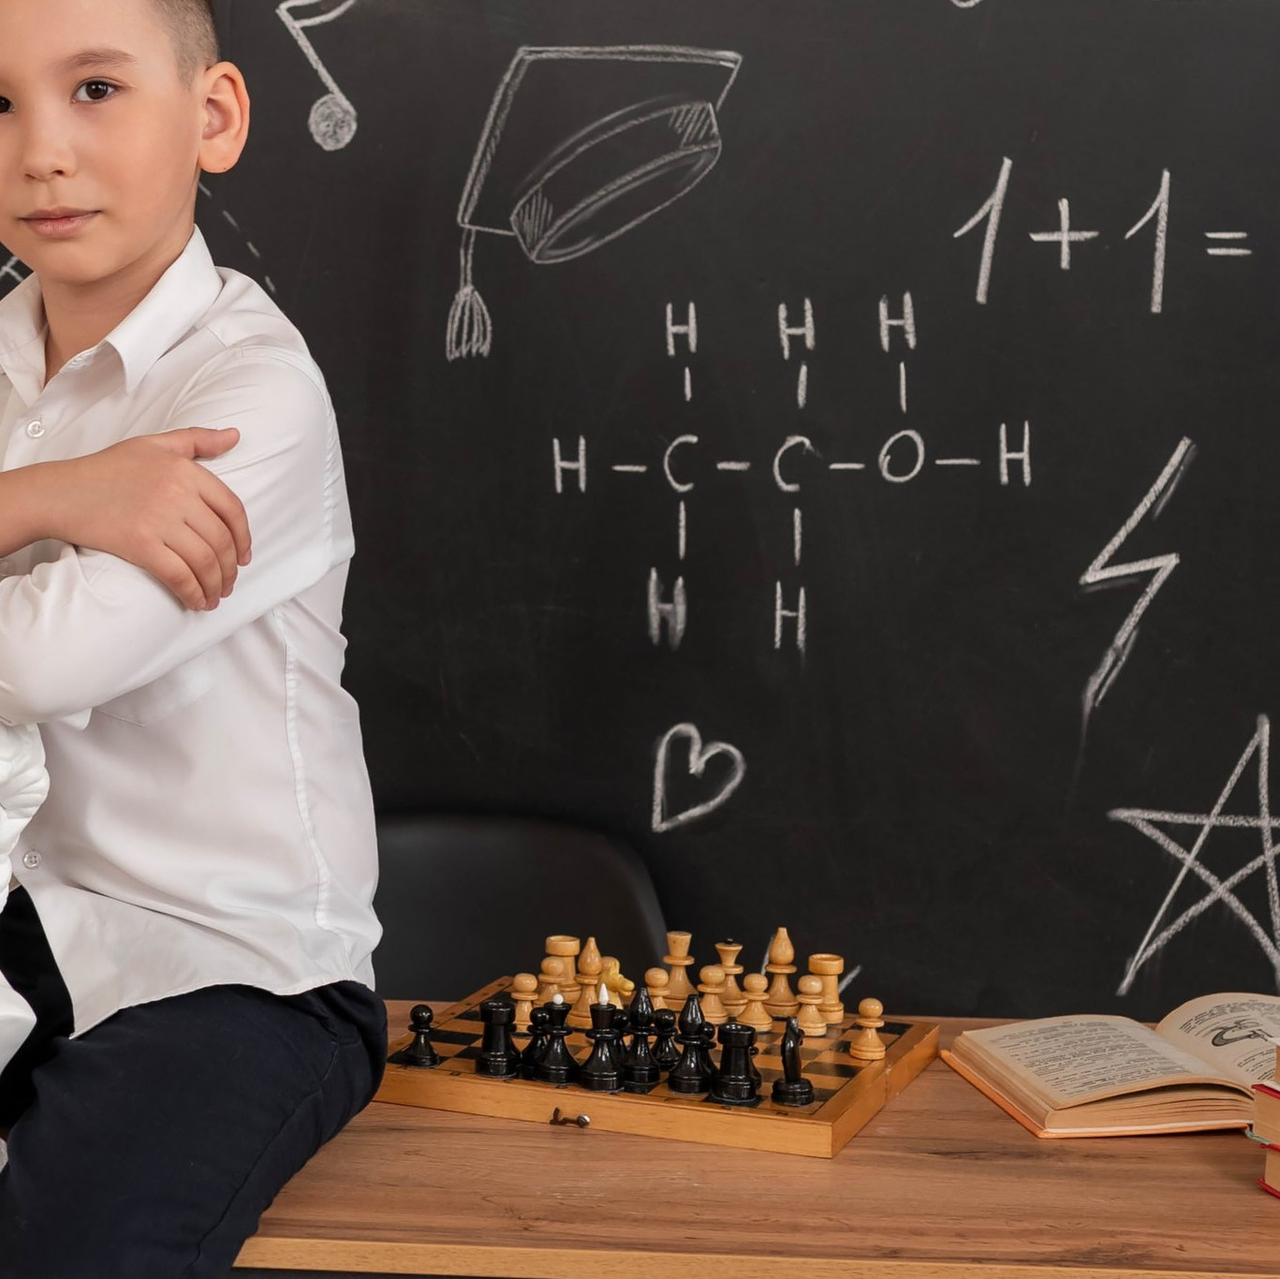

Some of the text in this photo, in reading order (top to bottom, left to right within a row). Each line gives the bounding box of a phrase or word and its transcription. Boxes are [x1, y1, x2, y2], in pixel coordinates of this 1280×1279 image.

[667, 303, 696, 355] H
[779, 299, 814, 359] H
[880, 292, 915, 351] H
[775, 582, 805, 647] H
